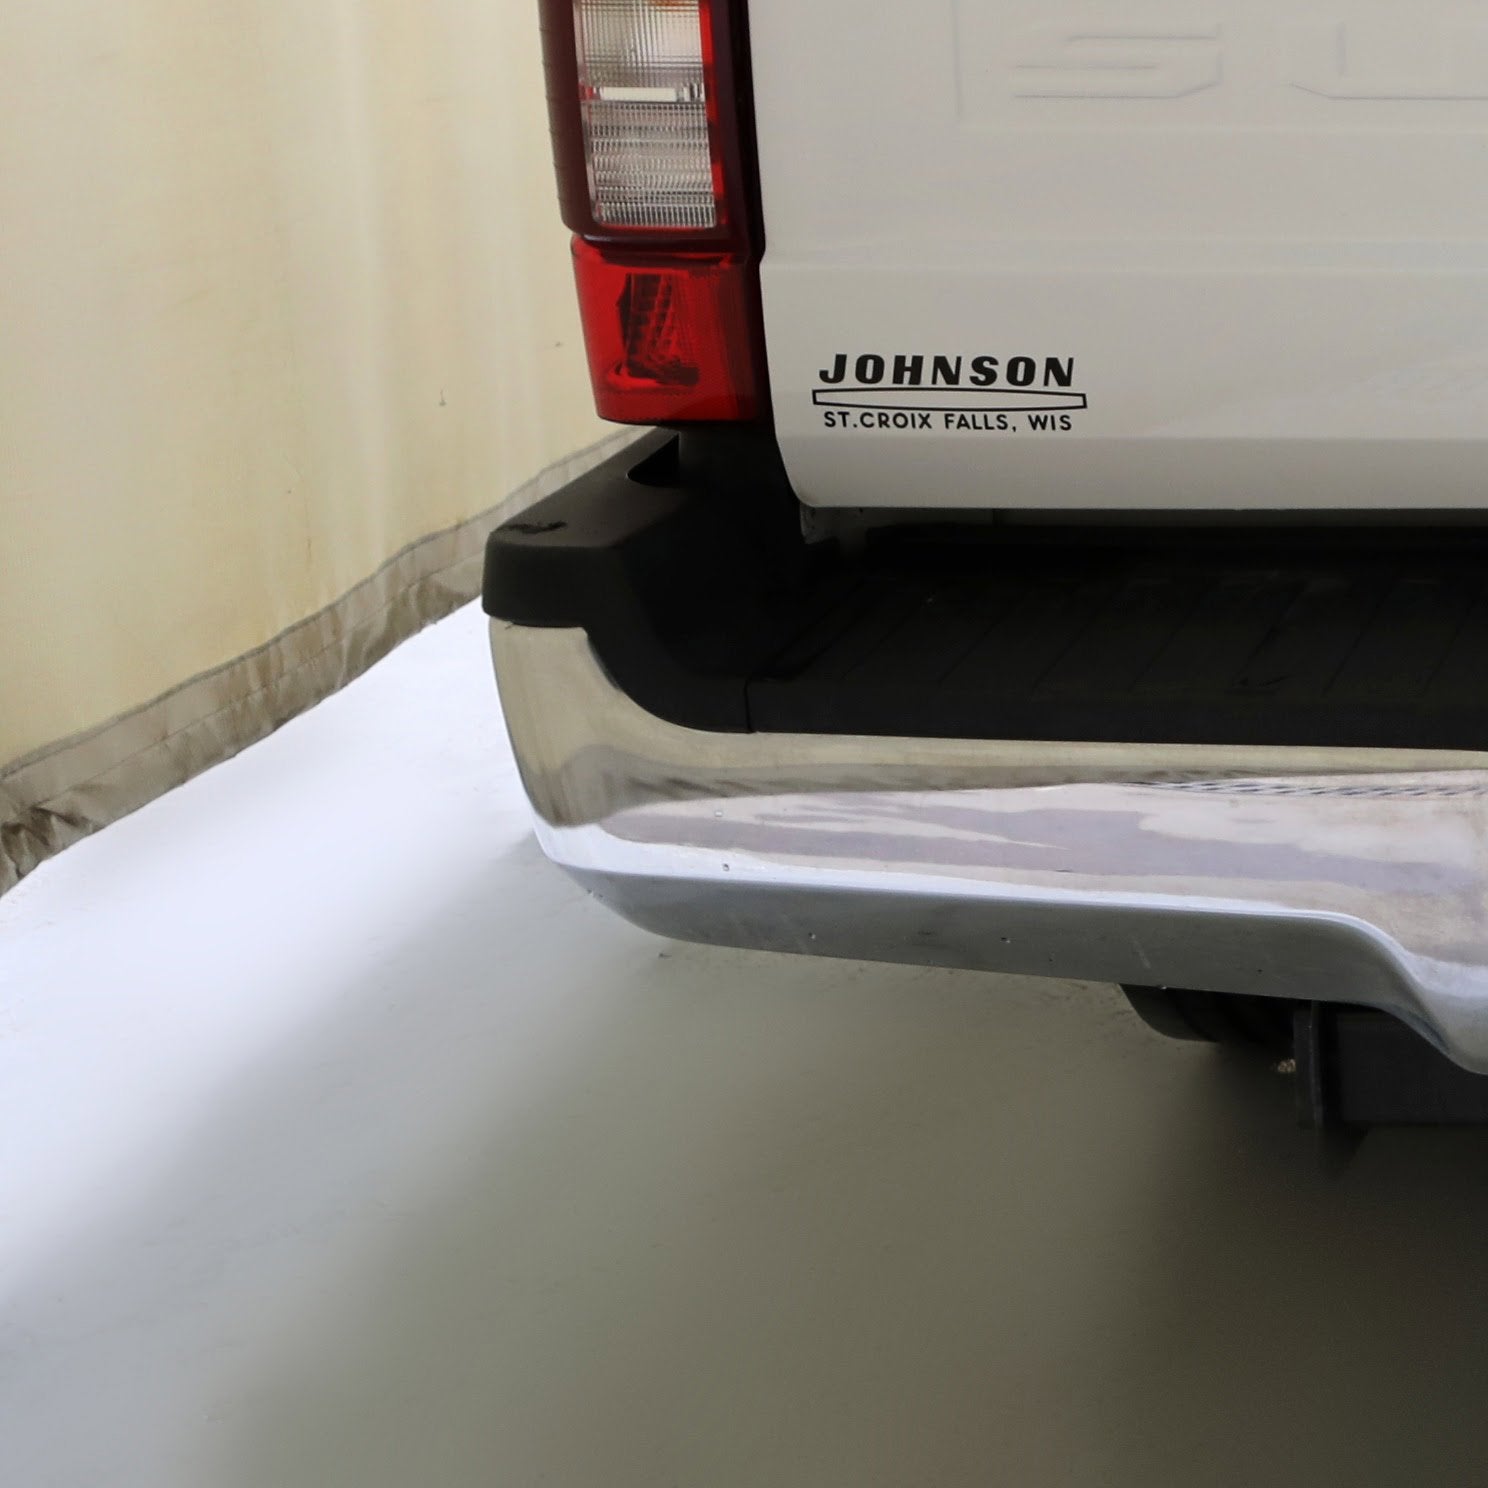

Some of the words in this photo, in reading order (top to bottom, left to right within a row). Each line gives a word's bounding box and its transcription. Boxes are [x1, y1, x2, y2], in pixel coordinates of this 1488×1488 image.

[818, 353, 1075, 388] JOHNSON
[943, 412, 1018, 432] FALLS,
[1027, 413, 1073, 432] WIS
